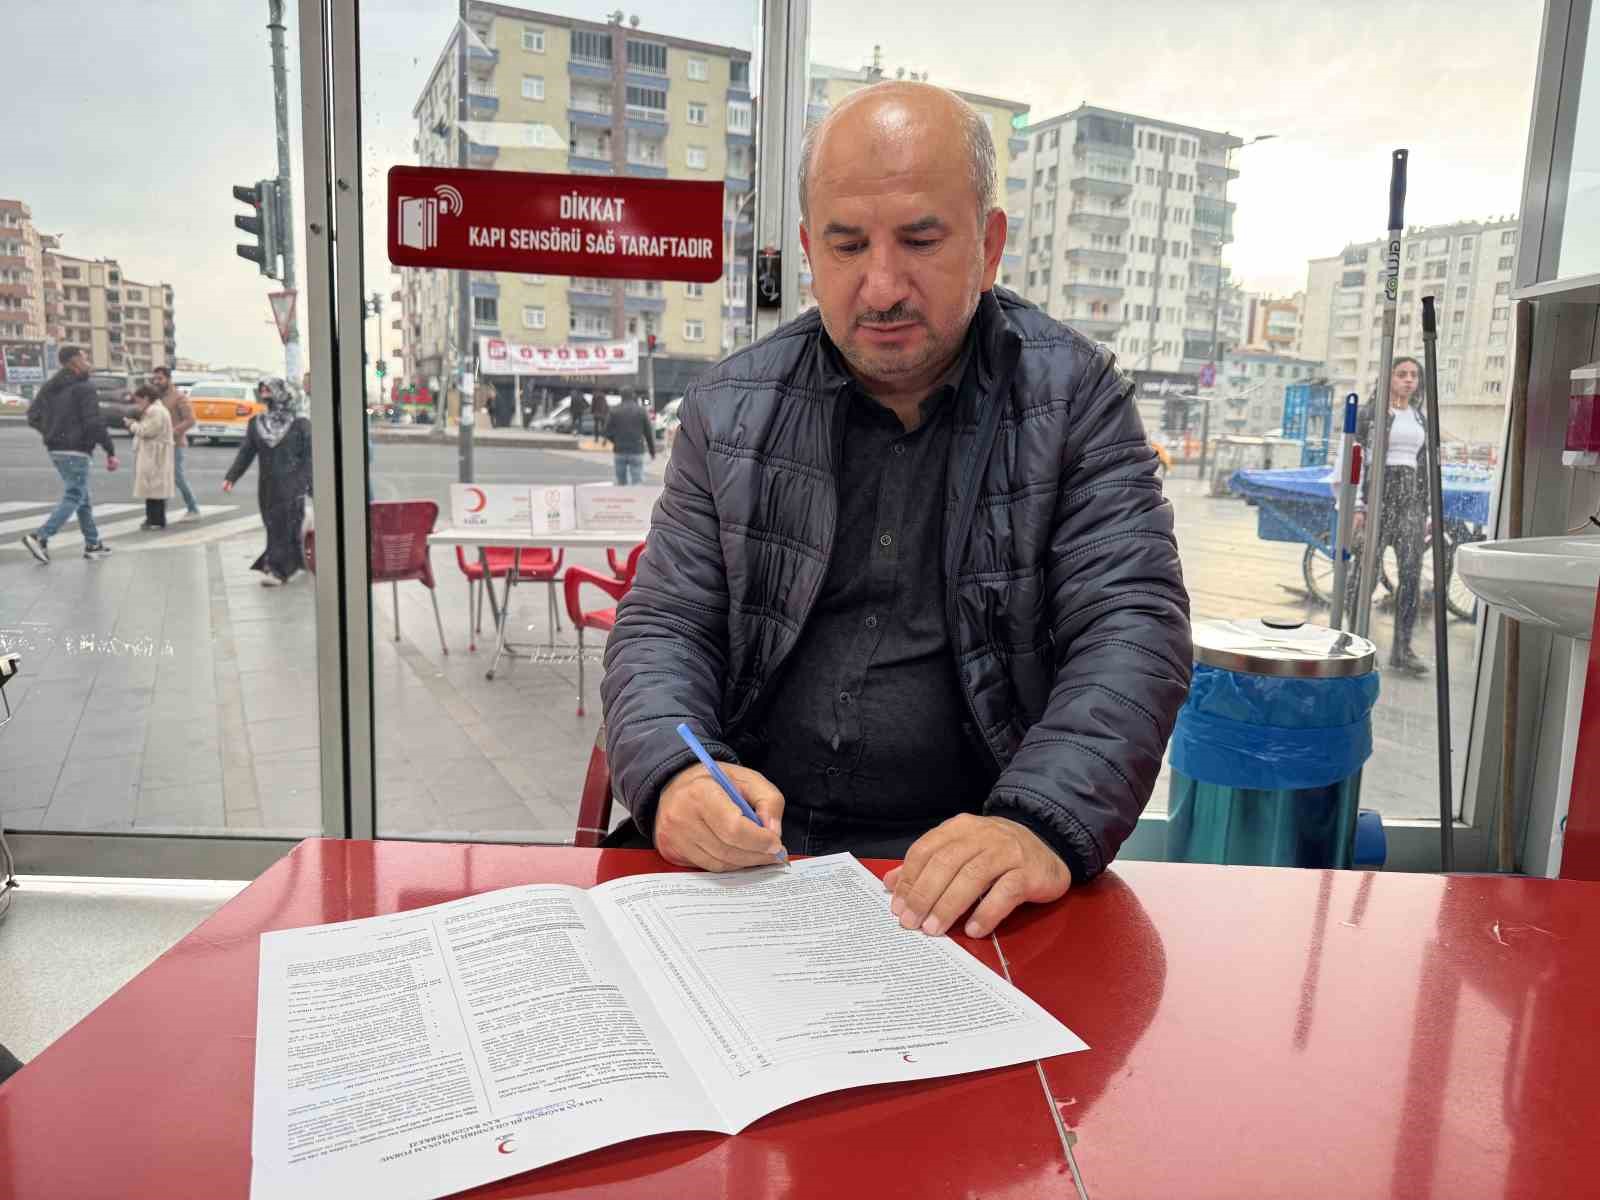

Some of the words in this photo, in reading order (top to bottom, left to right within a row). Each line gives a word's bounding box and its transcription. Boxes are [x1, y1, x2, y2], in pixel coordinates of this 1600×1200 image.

[560, 191, 625, 222] DİKKAT
[469, 226, 505, 248] KAPI
[509, 226, 580, 252] SENSÖRÜ
[586, 229, 616, 254] SAĞ
[619, 233, 713, 259] TARAFTADIR
